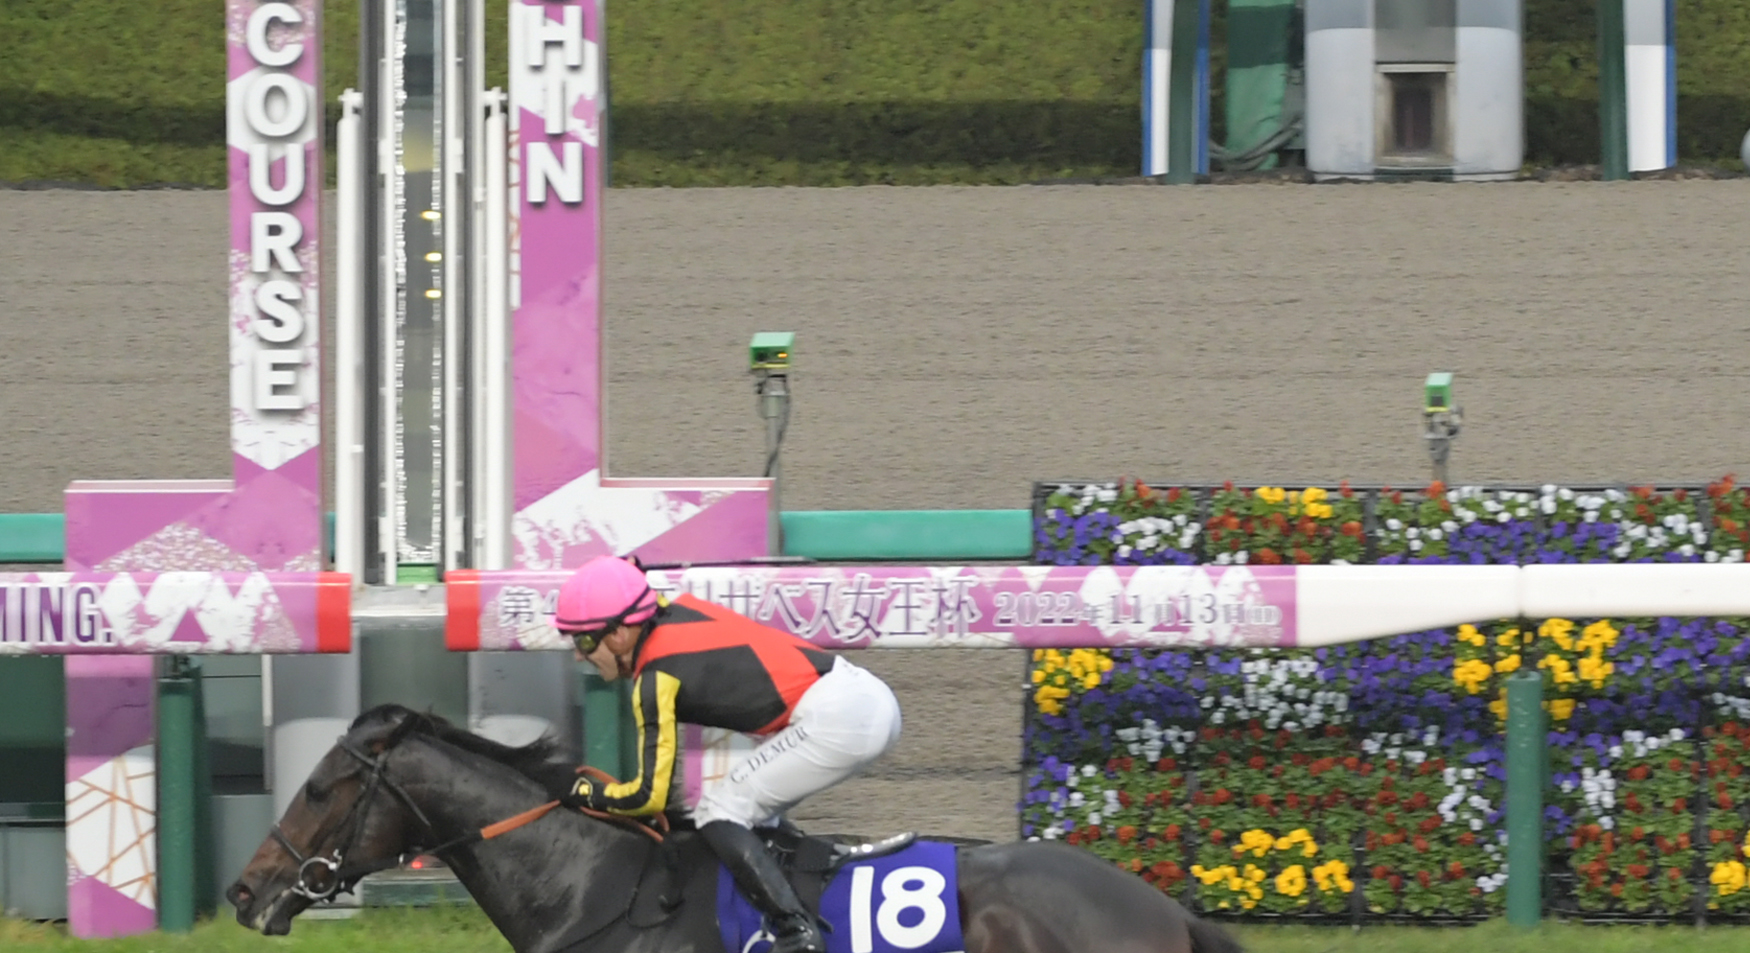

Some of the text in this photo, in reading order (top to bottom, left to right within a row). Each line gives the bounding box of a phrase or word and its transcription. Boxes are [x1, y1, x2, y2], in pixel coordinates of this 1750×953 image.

[245, 2, 308, 410] COURSE
[0, 584, 114, 644] ING.
[650, 574, 981, 642] ザベス女王杯
